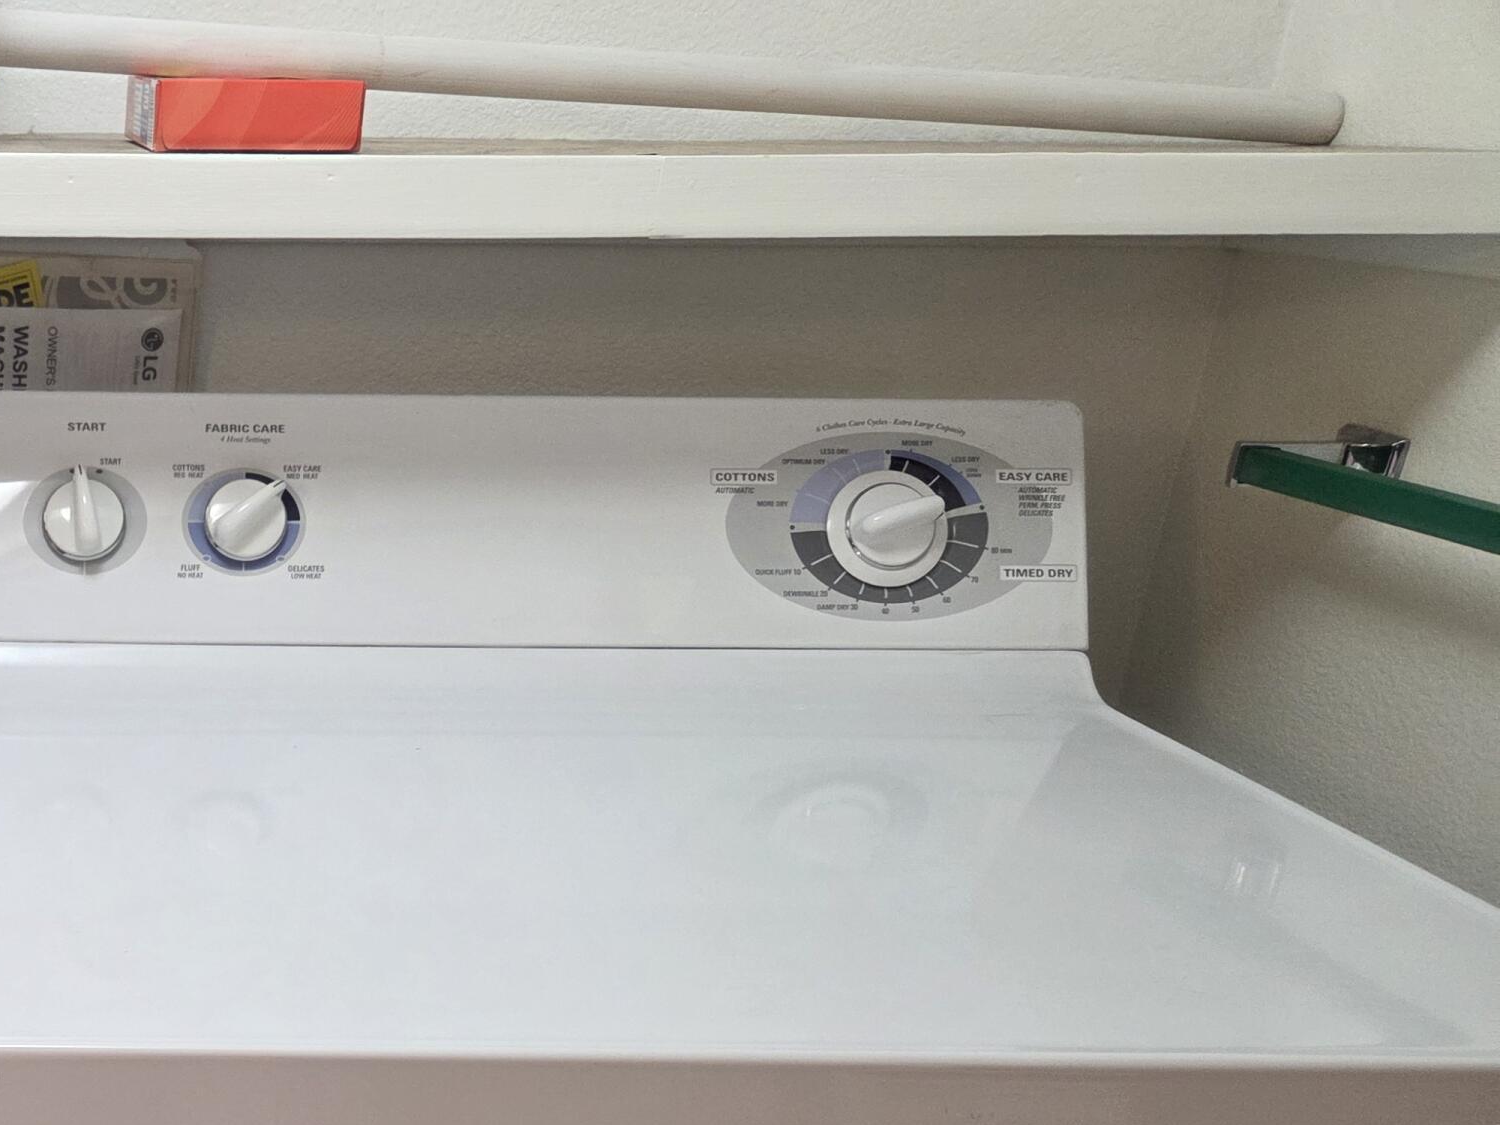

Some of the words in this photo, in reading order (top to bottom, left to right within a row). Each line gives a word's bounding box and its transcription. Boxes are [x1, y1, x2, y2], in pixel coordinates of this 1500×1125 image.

[142, 355, 158, 381] LG
[67, 422, 107, 431] START
[205, 423, 250, 433] FABRIC
[252, 424, 285, 434] CARE
[715, 472, 775, 482] COTTONS
[999, 472, 1031, 481] EASY
[1035, 472, 1068, 482] CARE
[180, 564, 200, 572] FLUFF
[1004, 568, 1044, 578] TIMED
[1048, 568, 1073, 578] DRY
